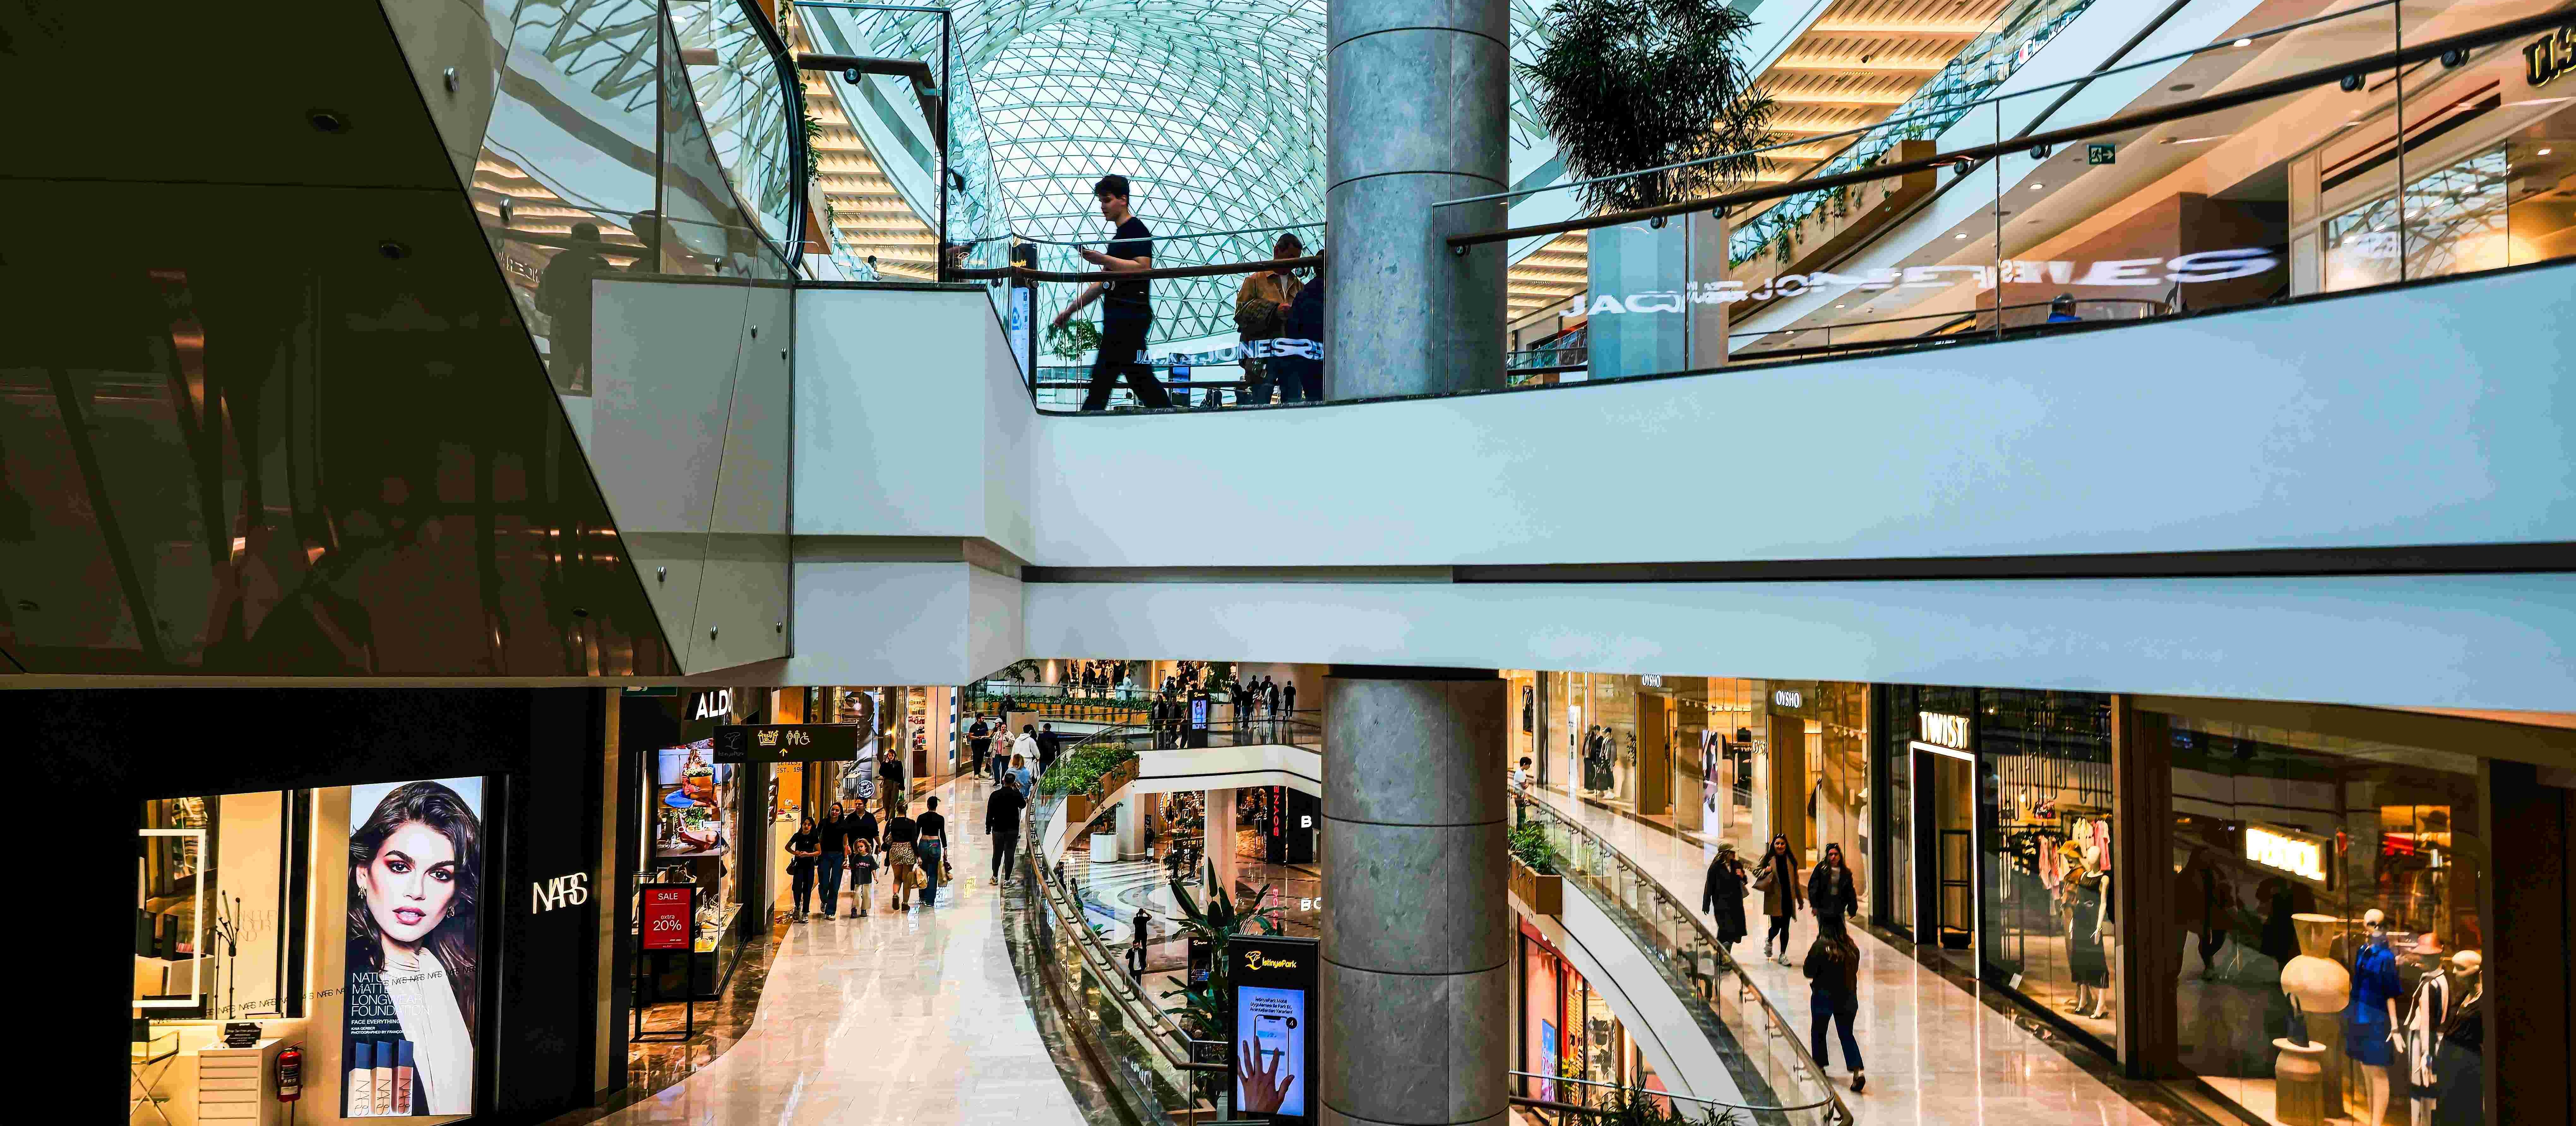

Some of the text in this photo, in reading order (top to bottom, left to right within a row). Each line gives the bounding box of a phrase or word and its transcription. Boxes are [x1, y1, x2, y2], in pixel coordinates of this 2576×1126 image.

[1642, 674, 1661, 688] OYSHO
[695, 687, 732, 720] ALDO
[1776, 690, 1800, 708] OYSHO
[1919, 711, 1967, 749] TWIST
[533, 872, 587, 914] NARS
[653, 920, 682, 931] 20%
[239, 1002, 256, 1010] NARS
[317, 988, 333, 998] NARS
[428, 971, 442, 979] NARS
[352, 995, 422, 1005] LONGWEAR
[351, 1005, 432, 1016] FOUNDATION
[376, 1079, 391, 1115] NARS
